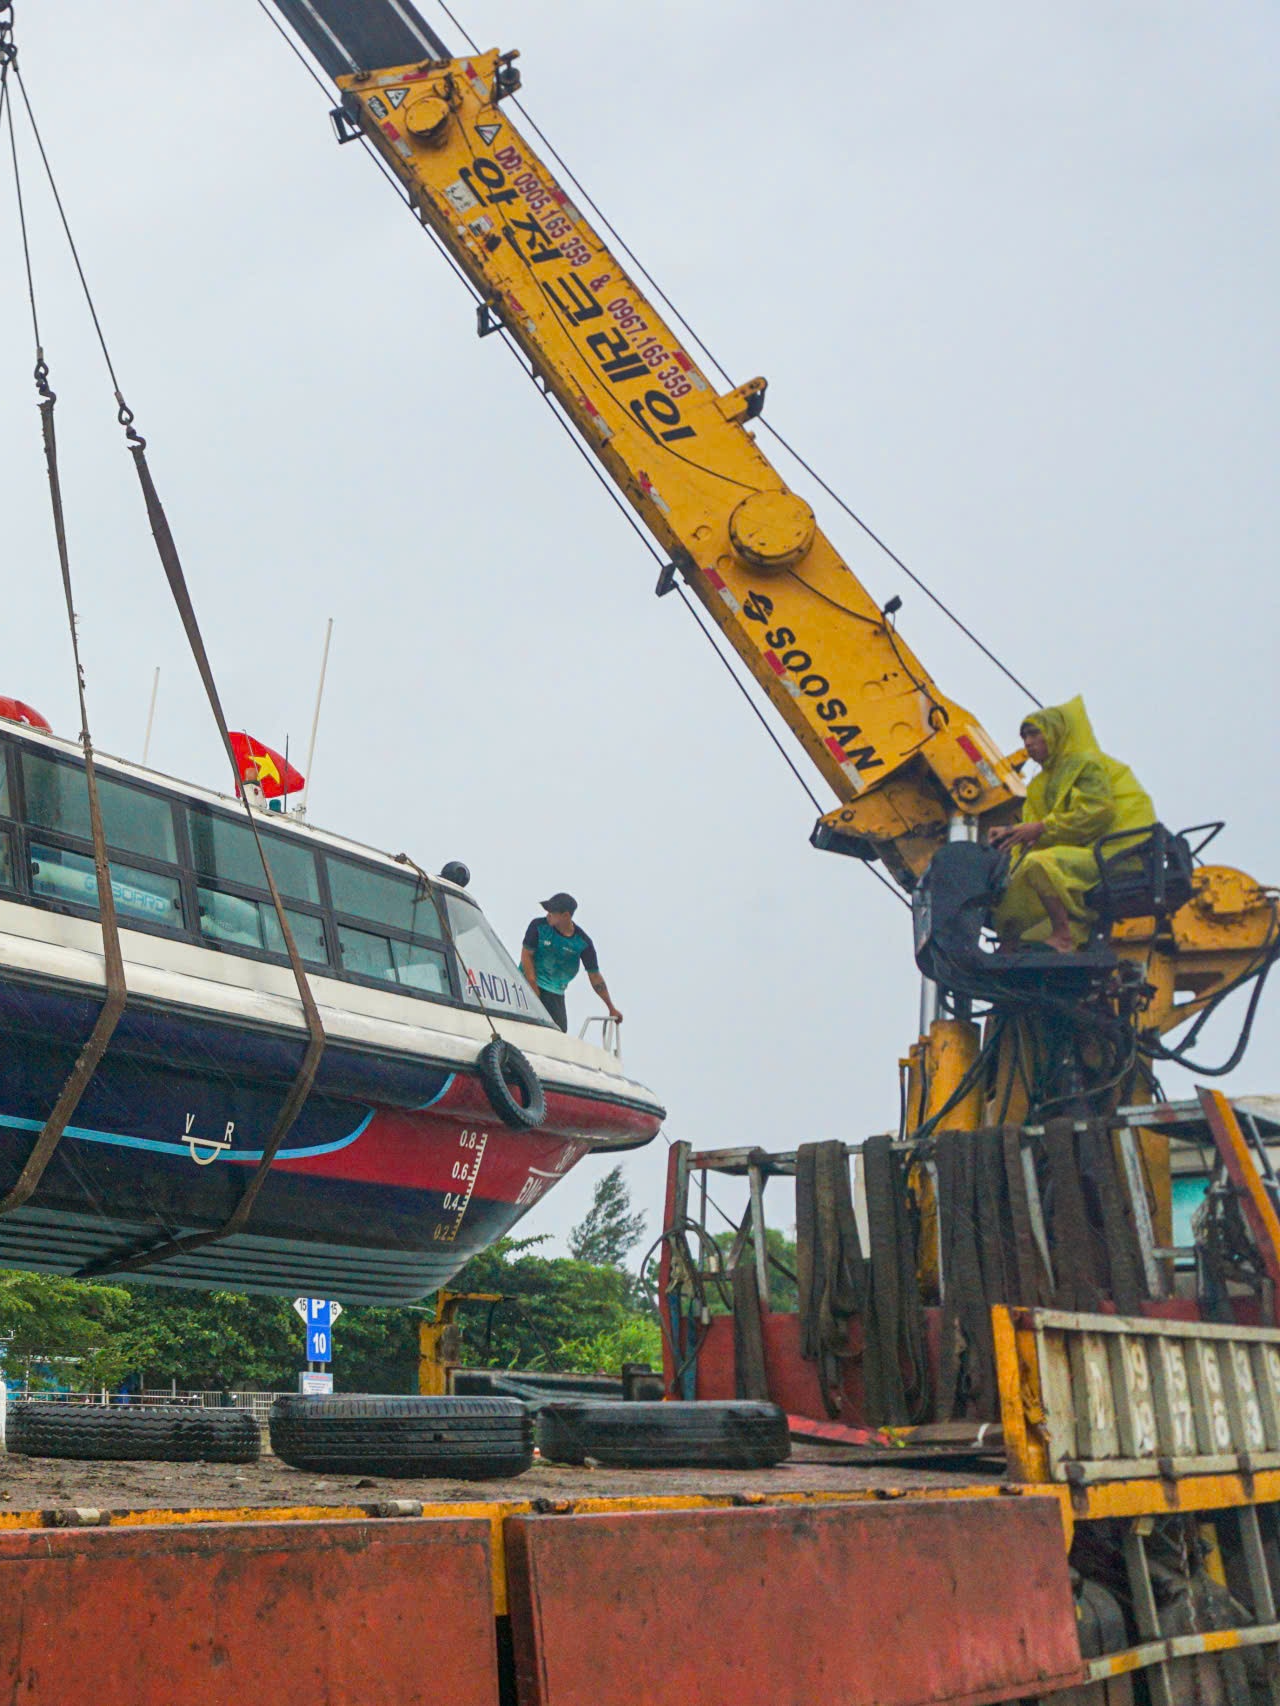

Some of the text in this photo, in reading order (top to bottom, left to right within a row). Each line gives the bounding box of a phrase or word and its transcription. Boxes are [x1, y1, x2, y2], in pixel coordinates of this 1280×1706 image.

[513, 172, 572, 239] 0905.165
[560, 236, 592, 267] 359
[589, 274, 611, 293] &
[607, 297, 670, 367] 0967.165
[657, 365, 692, 398] 359
[458, 156, 697, 444] 안전크레인
[765, 626, 885, 772] SOOSAN
[466, 968, 512, 1006] ANDI
[185, 1112, 235, 1143] V R
[459, 1129, 477, 1149] 0.8
[451, 1161, 469, 1181] 0.6
[443, 1192, 461, 1211] 0.4
[433, 1224, 449, 1241] 0.2
[299, 1298, 307, 1312] 15
[311, 1299, 326, 1319] P
[330, 1303, 338, 1316] 15
[312, 1332, 327, 1354] 10
